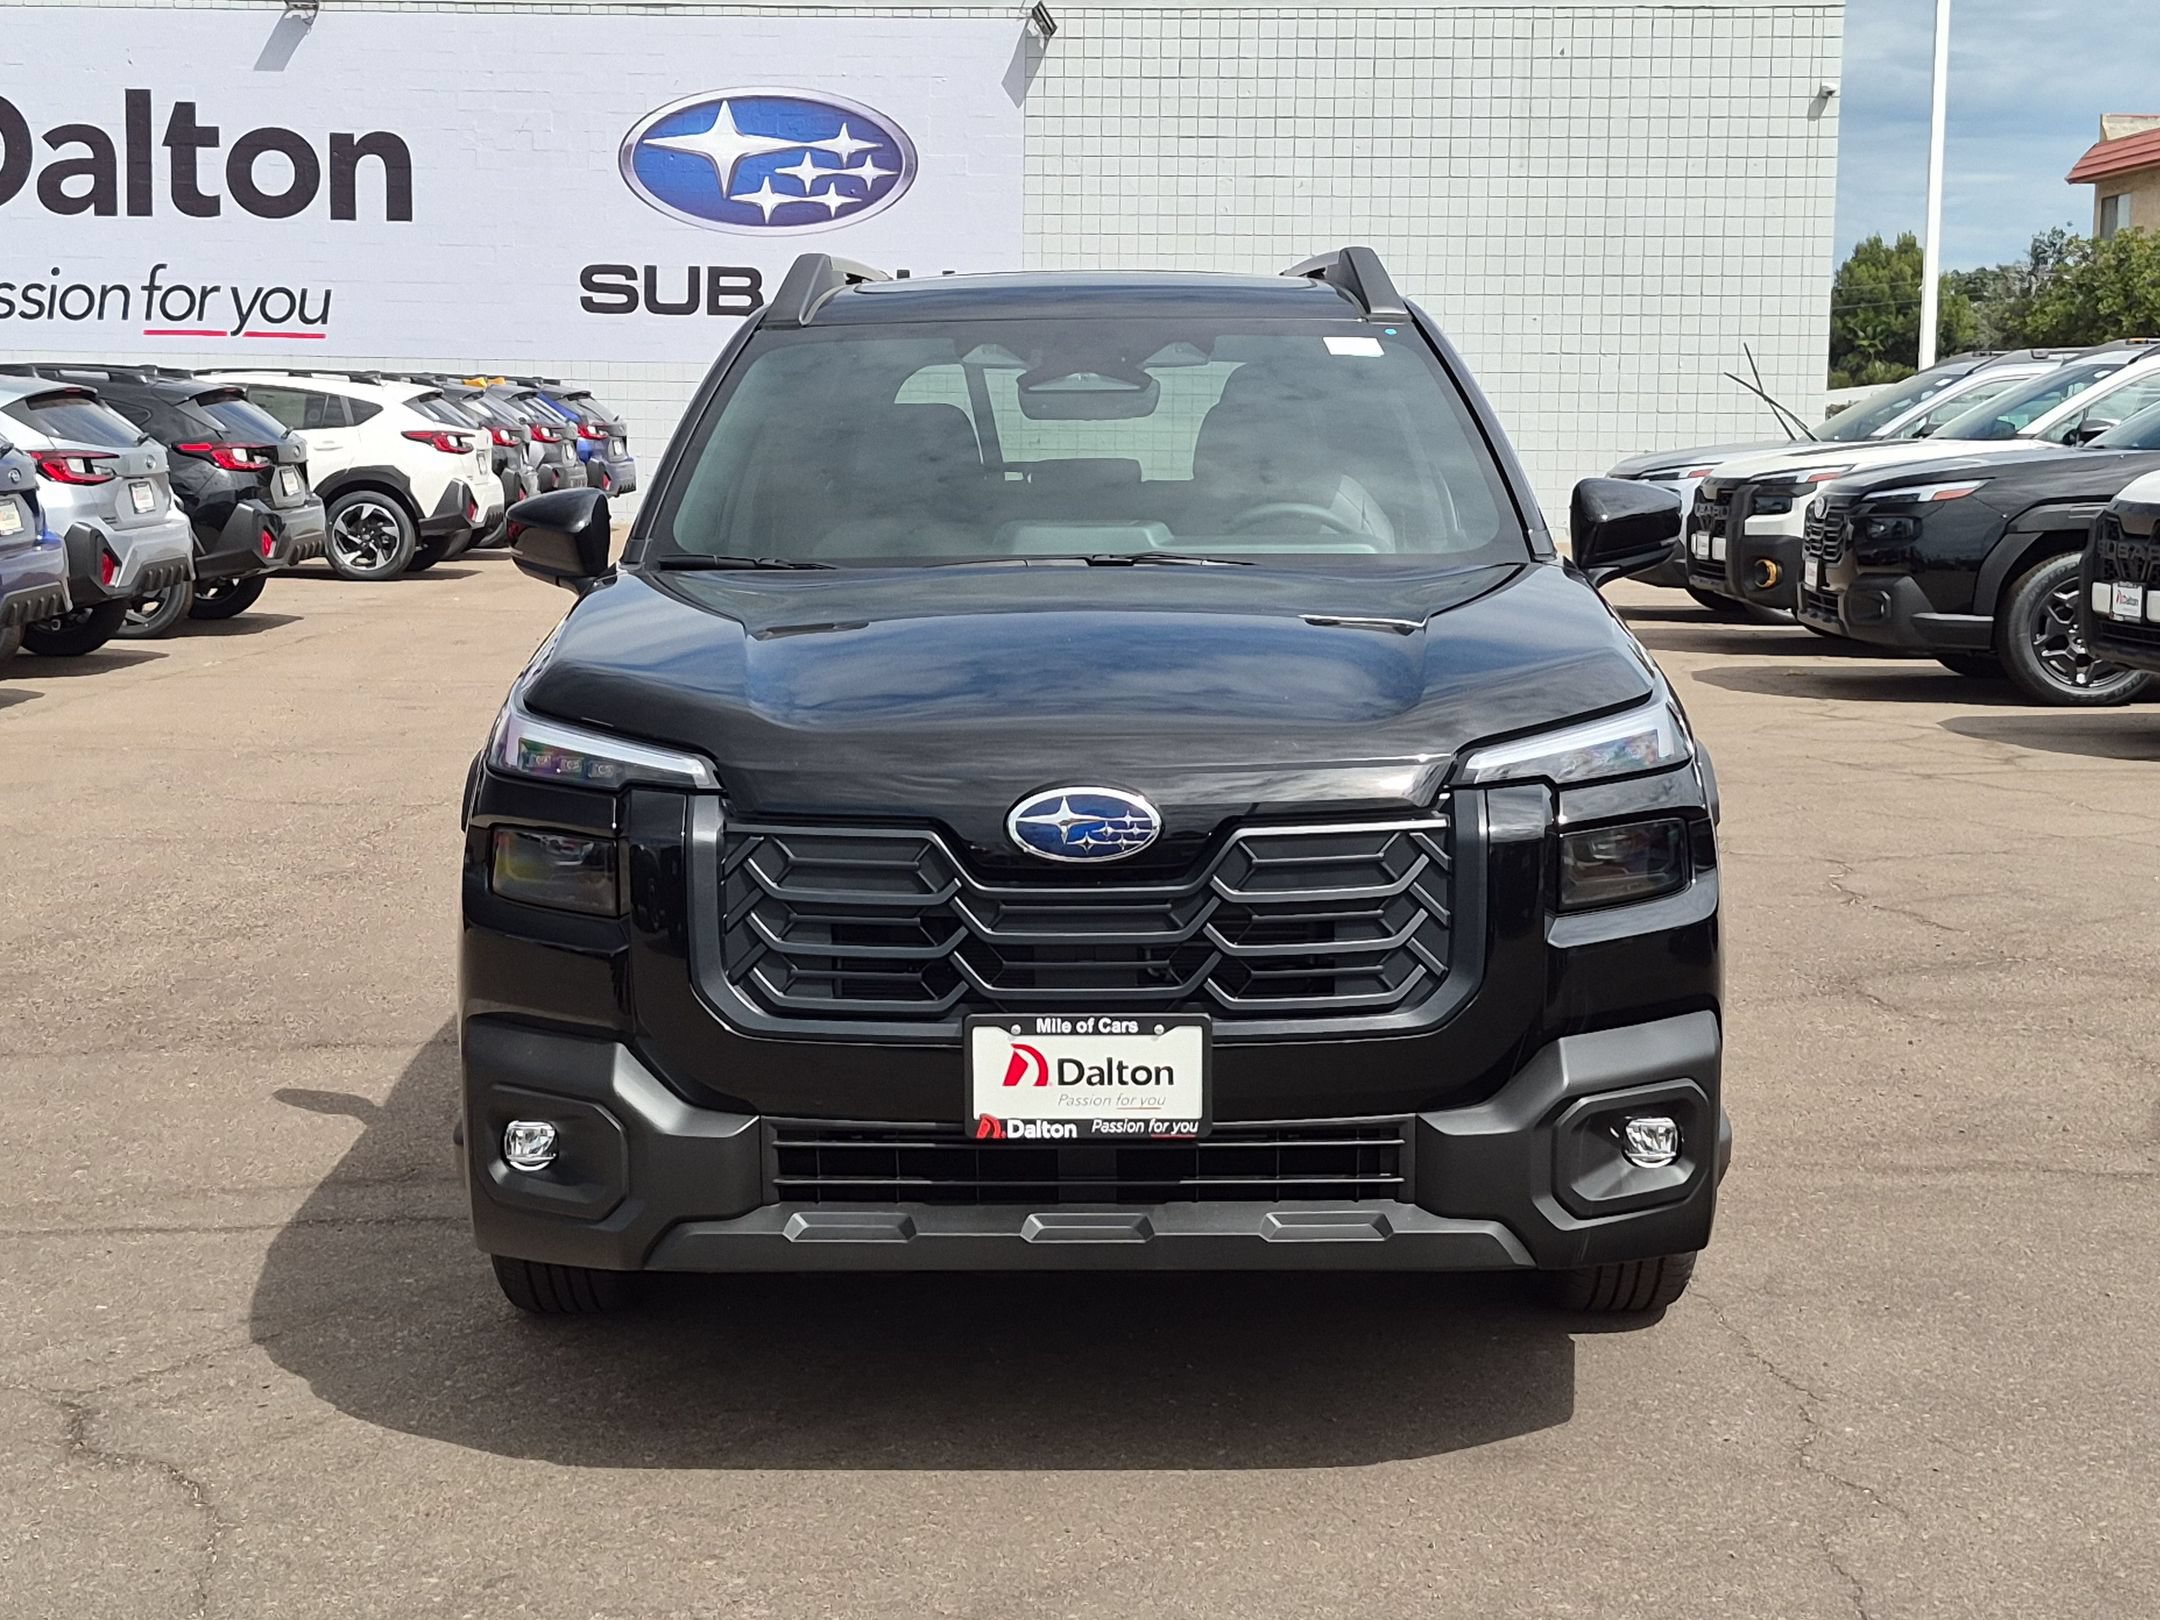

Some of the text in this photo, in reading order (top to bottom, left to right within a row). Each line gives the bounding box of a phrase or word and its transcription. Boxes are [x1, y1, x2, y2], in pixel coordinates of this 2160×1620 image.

[0, 89, 413, 221] alton
[141, 263, 221, 321] for
[230, 286, 332, 336] you
[1036, 1017, 1139, 1033] Mile of Cars
[1057, 1057, 1174, 1087] Dalton
[1057, 1092, 1166, 1108] Passion for you
[1007, 1118, 1199, 1139] Dalton Passion for you
